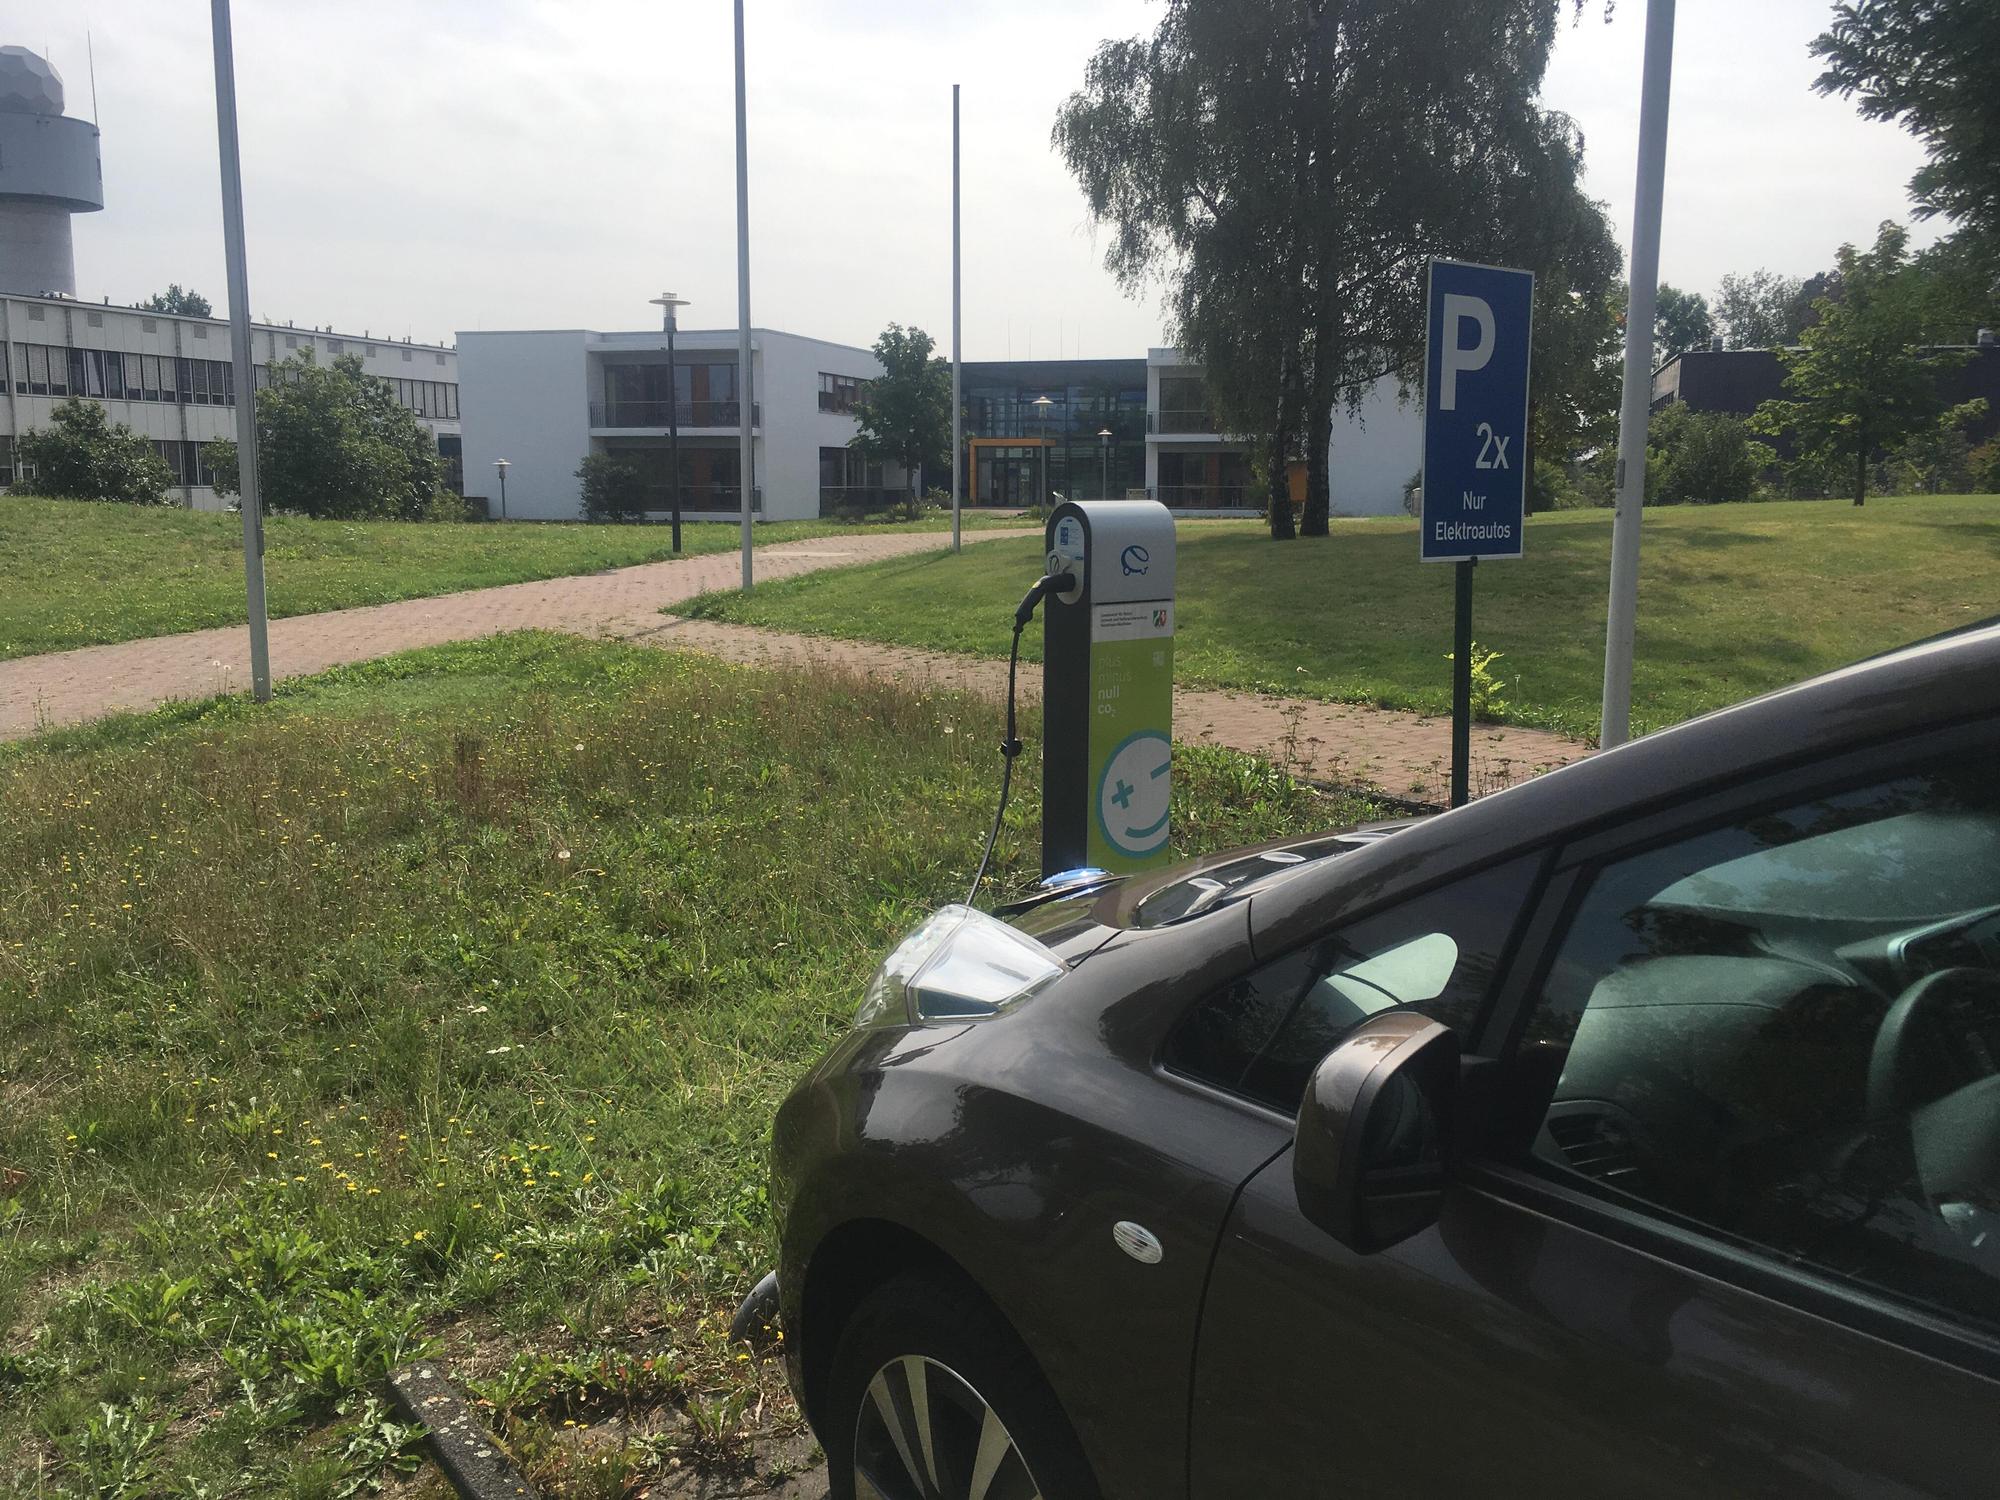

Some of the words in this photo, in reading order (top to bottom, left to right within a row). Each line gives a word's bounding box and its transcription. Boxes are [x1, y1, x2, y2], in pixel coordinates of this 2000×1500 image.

[1440, 293, 1496, 411] P
[1475, 422, 1511, 469] 2x
[1463, 491, 1487, 510] Nur
[1435, 521, 1511, 541] Elektroautos
[1098, 684, 1120, 700] null
